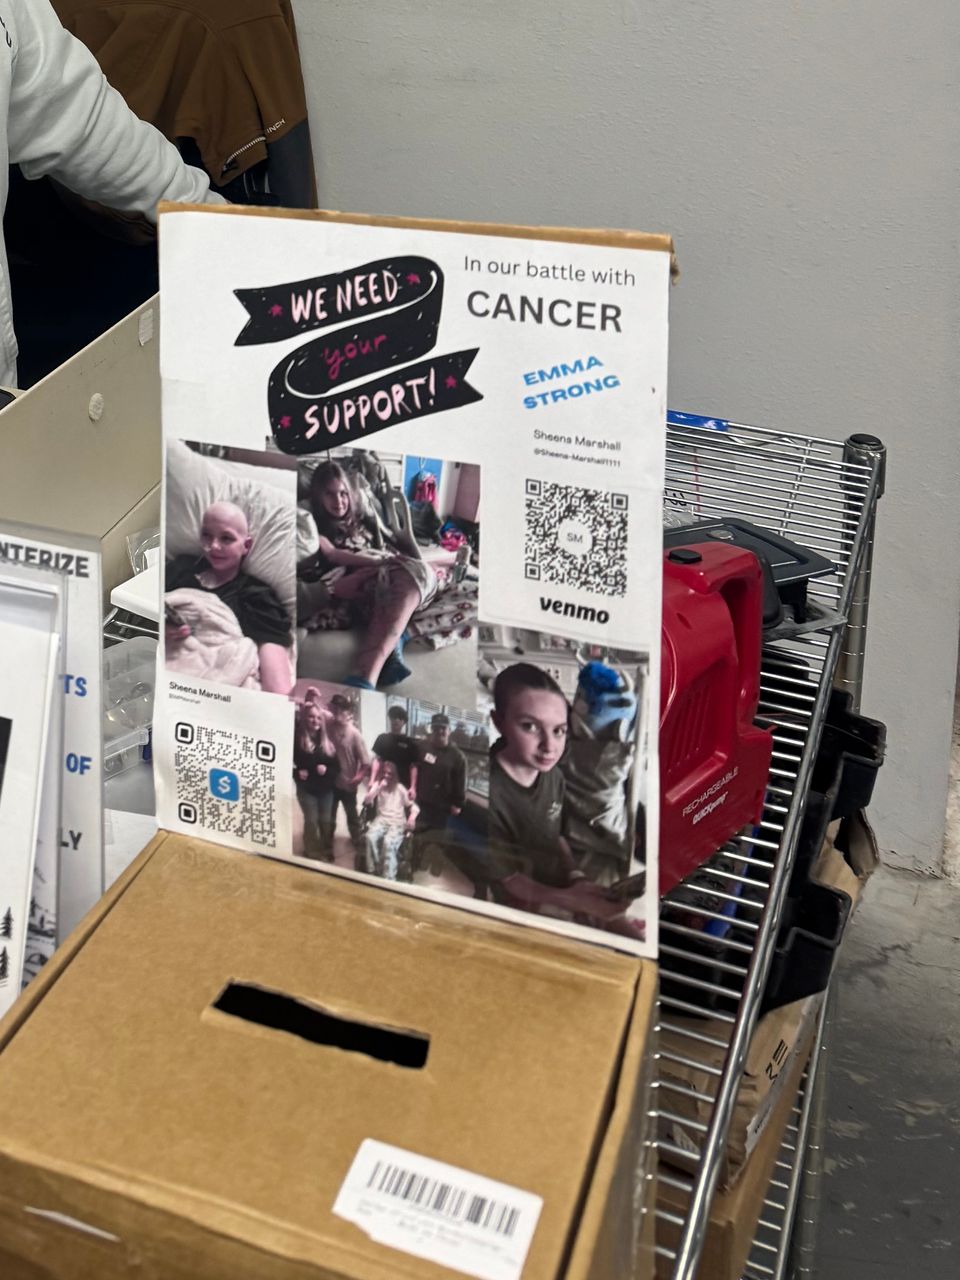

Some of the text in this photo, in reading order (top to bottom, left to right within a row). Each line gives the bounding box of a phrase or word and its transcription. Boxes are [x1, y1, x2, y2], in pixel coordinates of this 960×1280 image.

[464, 255, 636, 288] In our battle with
[291, 270, 398, 324] WE NEED
[467, 290, 622, 333] CANCER
[321, 334, 387, 381] your
[523, 356, 604, 386] EMMA
[304, 366, 436, 440] SUPPORT!
[523, 375, 620, 410] STRONG
[533, 429, 621, 452] Sheena Marshall
[566, 532, 583, 544] SM
[539, 596, 610, 625] venmo
[169, 681, 198, 695] Sheena
[199, 688, 232, 703] Marshall
[65, 753, 92, 776] OF
[682, 766, 738, 818] RECHARGEABLE
